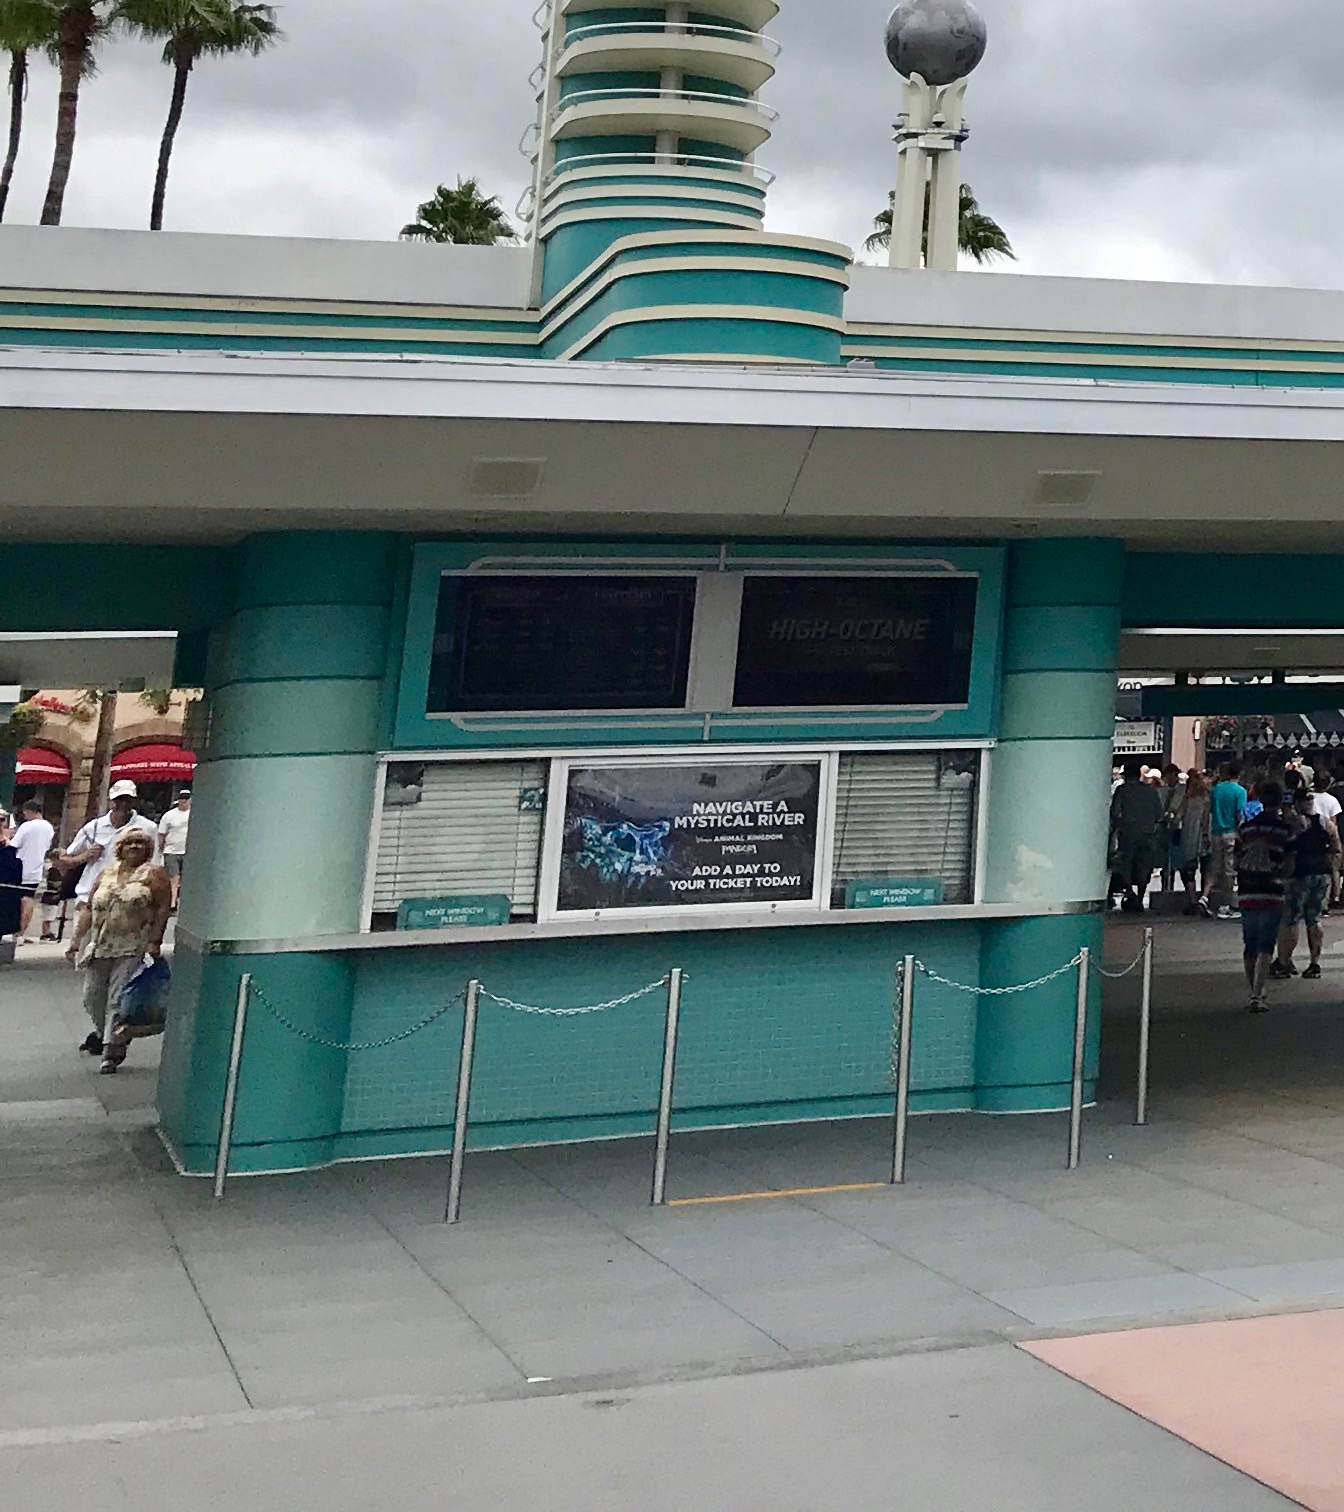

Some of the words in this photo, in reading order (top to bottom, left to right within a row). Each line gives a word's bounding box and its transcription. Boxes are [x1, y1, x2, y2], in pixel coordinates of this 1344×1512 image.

[769, 618, 929, 640] HIGH-OCTANE
[692, 800, 773, 815] NAVIGATE
[776, 800, 789, 813] A
[674, 814, 755, 829] MYSTICAL
[757, 813, 805, 826] RIVER
[692, 865, 721, 876] ADD
[723, 864, 733, 875] A
[735, 863, 760, 875] DAY
[763, 863, 781, 873] TO
[669, 879, 706, 891] YOUR
[708, 877, 752, 889] TICKET
[755, 876, 801, 887] TODAY!
